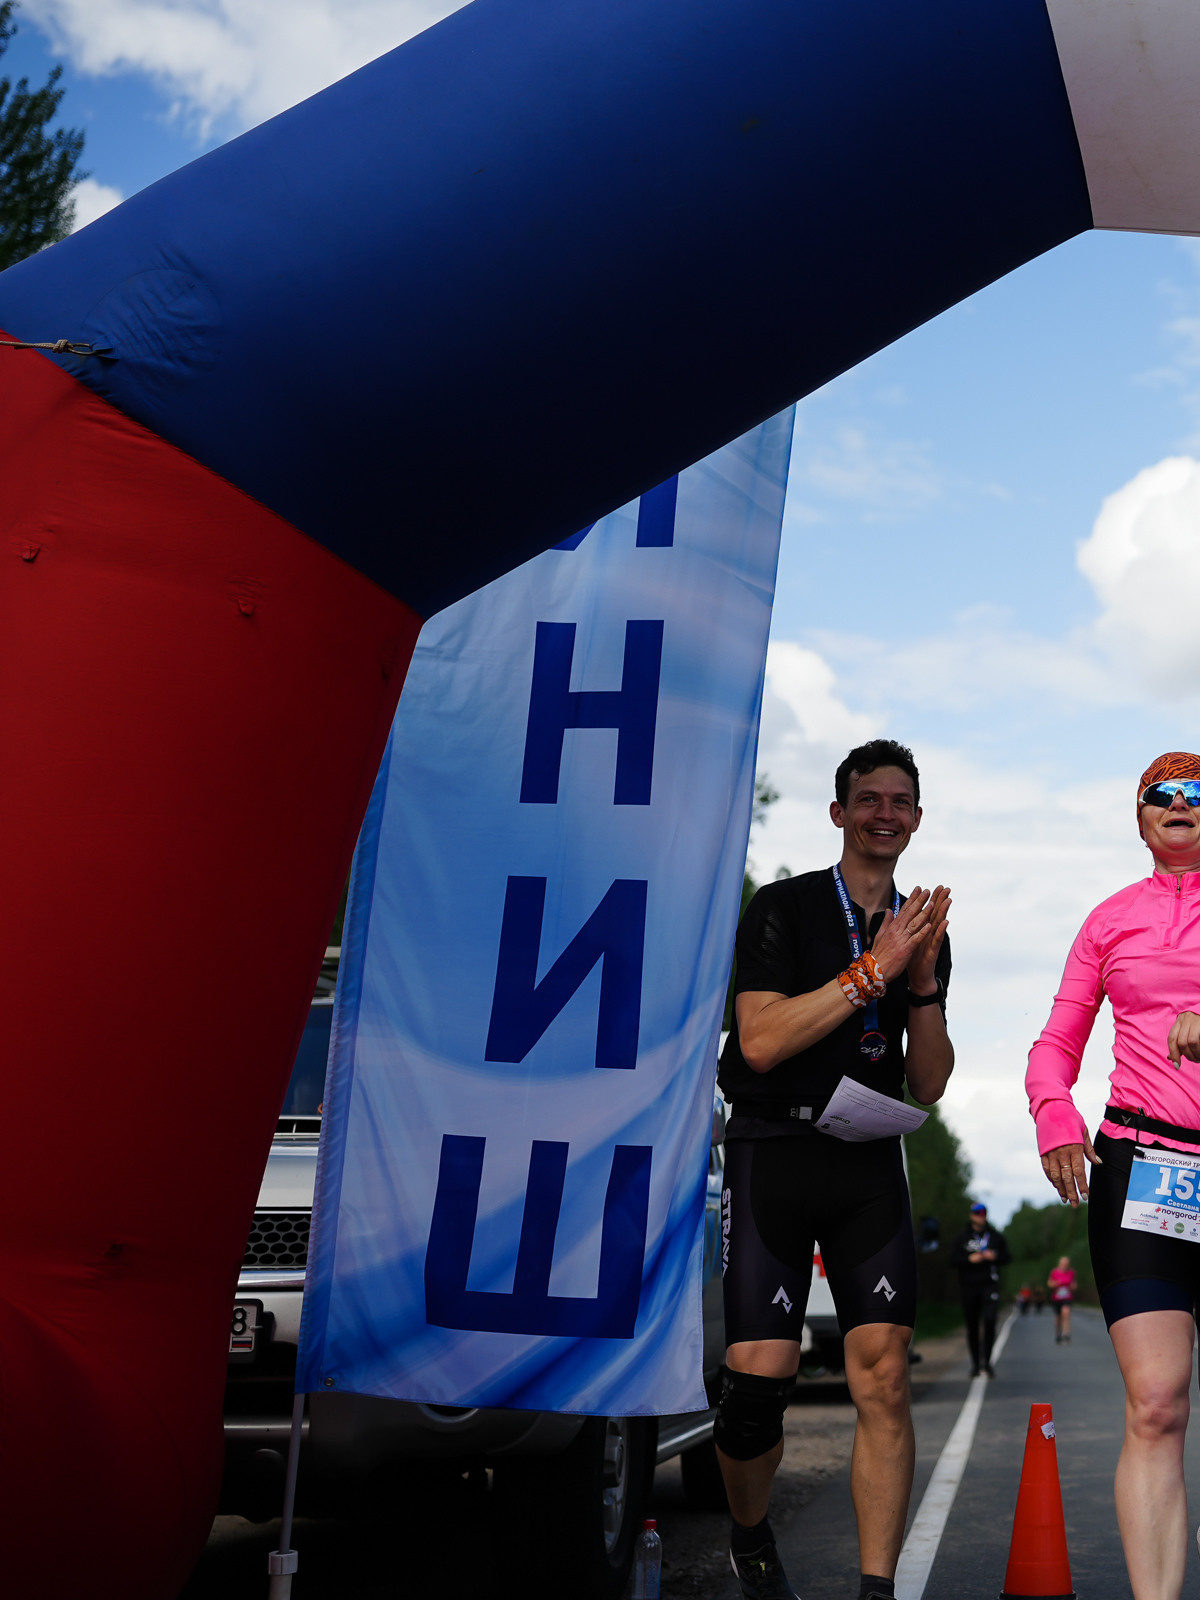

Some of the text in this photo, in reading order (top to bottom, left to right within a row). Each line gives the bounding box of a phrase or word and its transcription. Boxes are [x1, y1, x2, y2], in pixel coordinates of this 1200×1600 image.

[425, 472, 679, 1339] НИШ
[845, 910, 855, 927] 2023
[1167, 1199, 1200, 1212] Светлана
